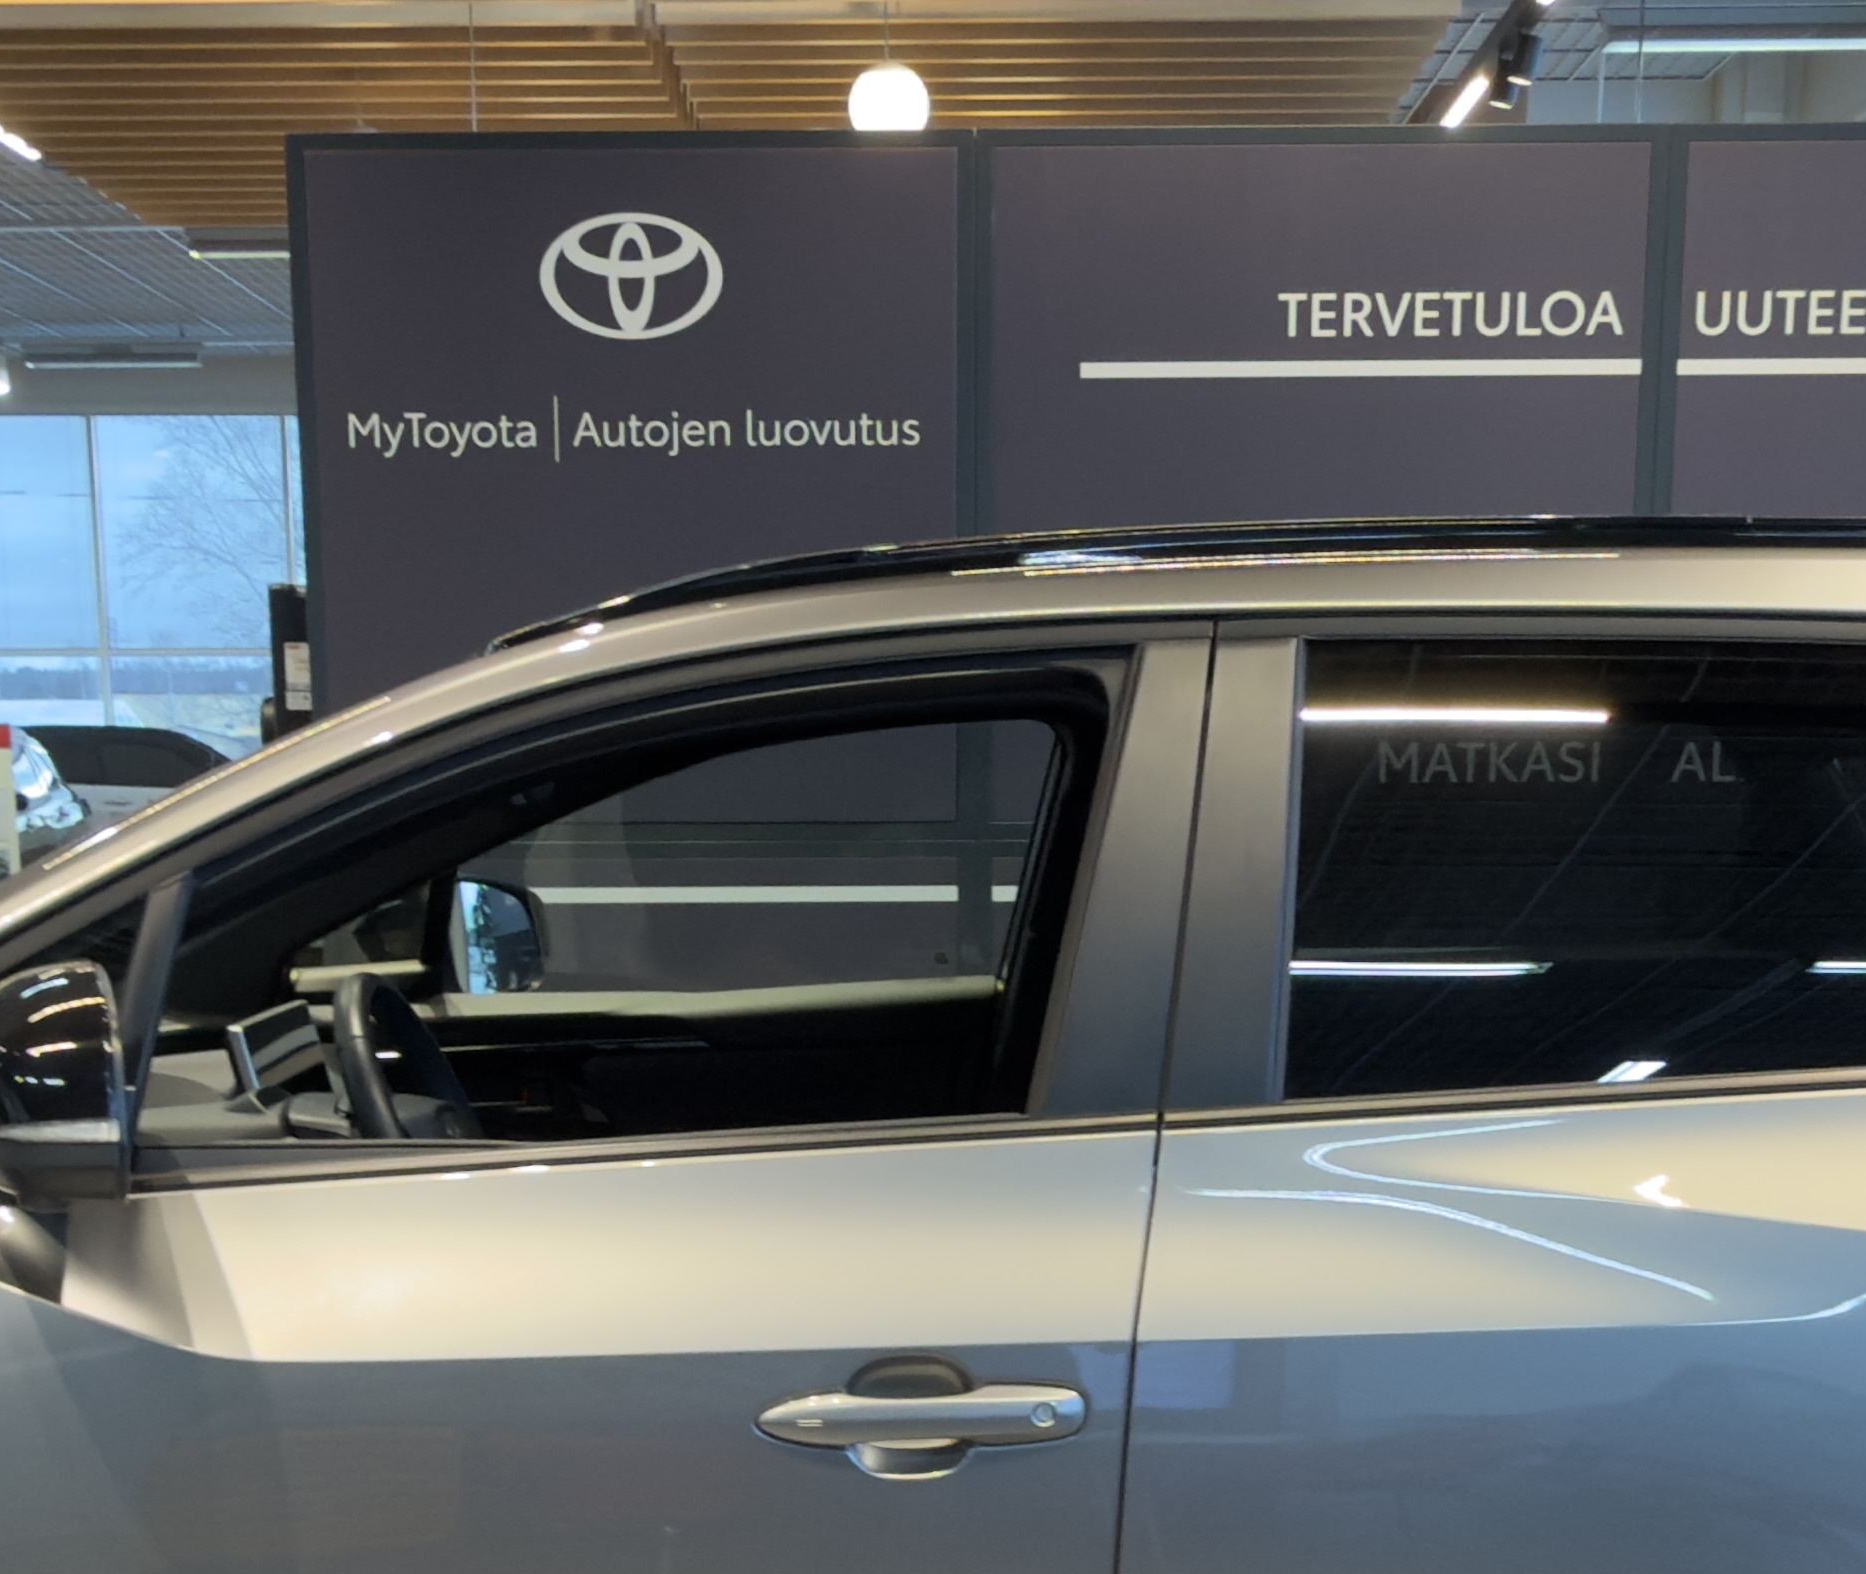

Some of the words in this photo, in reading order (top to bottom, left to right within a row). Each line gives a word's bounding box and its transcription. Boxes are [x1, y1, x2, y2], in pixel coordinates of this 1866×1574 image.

[1277, 290, 1625, 338] TERVETULOA
[347, 411, 538, 458] MyToyota
[572, 410, 732, 457] Autojen
[745, 408, 922, 448] luovutus
[1376, 740, 1602, 784] MATKASI
[1670, 740, 1745, 784] AL
